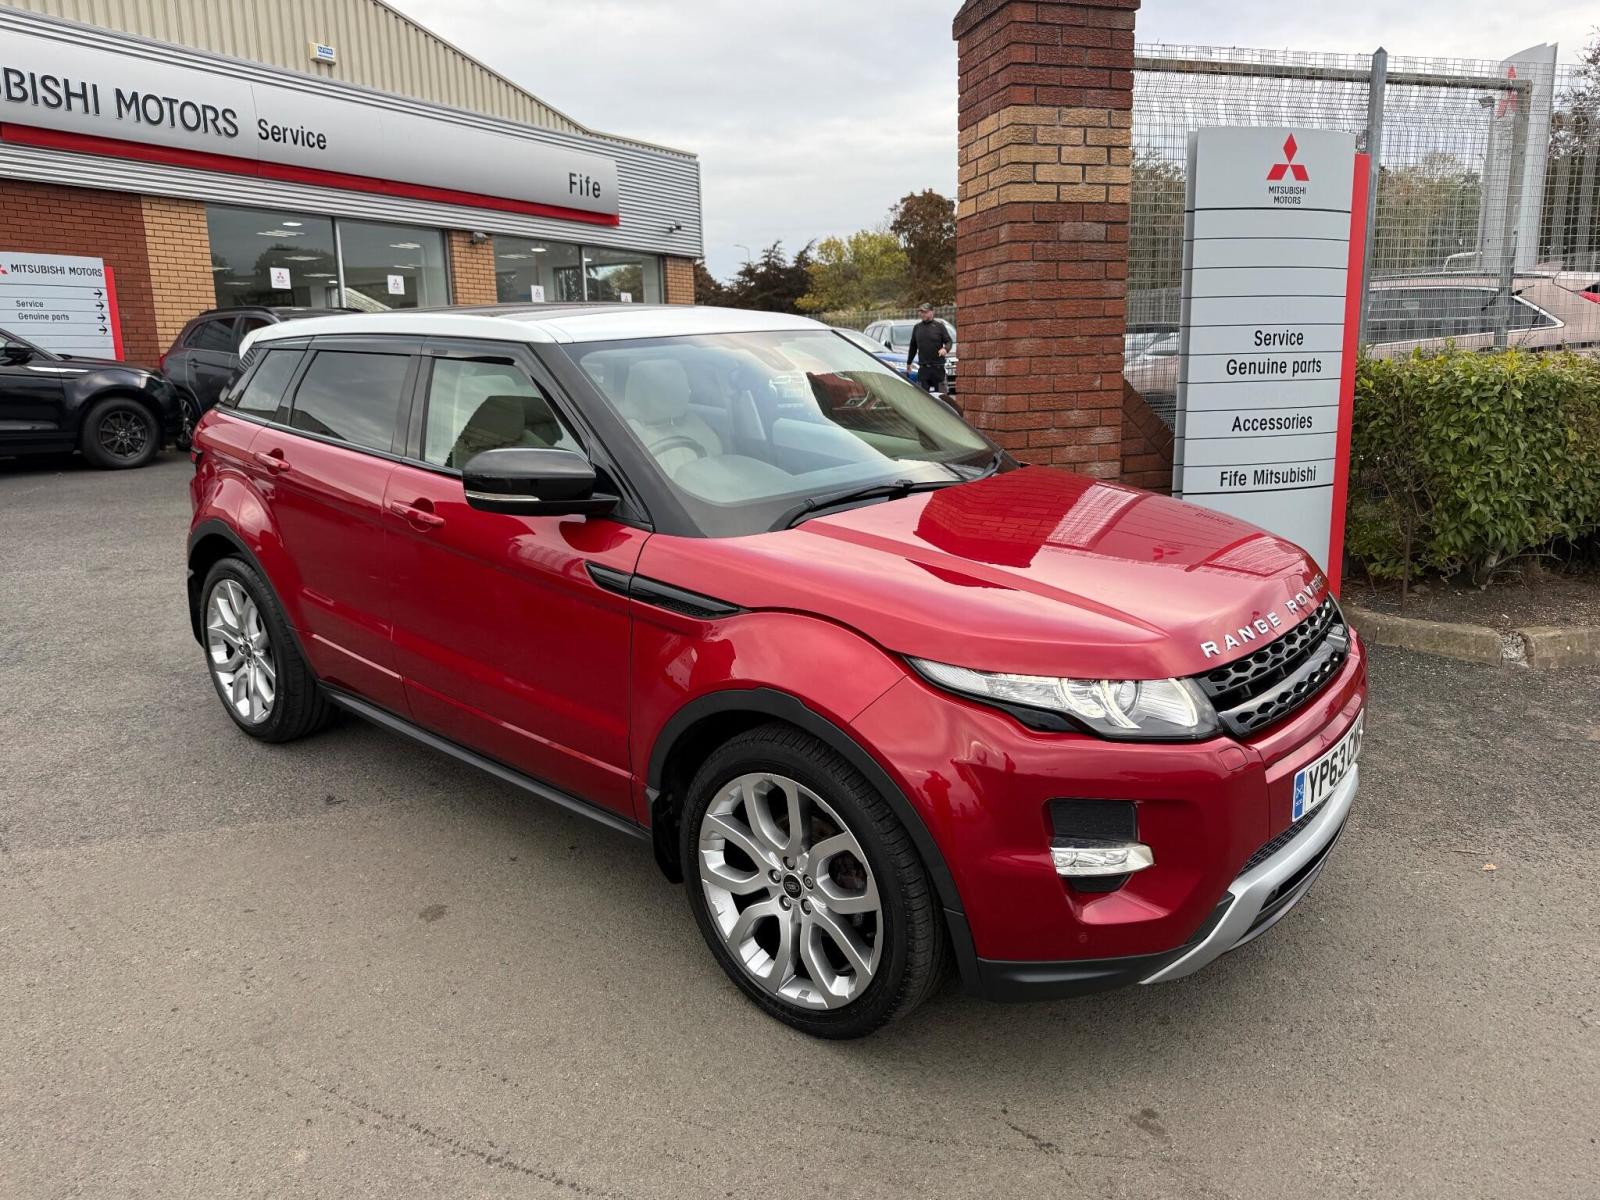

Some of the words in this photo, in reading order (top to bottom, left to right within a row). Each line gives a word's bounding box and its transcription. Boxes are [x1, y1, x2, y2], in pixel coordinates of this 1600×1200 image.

[0, 67, 100, 115] BISHI
[115, 87, 239, 137] MOTORS
[257, 118, 327, 150] Service
[569, 172, 601, 198] Fife
[1268, 185, 1307, 195] MITSUBISHI
[1273, 196, 1302, 204] MOTORS
[10, 264, 65, 275] MITSUBISHI
[68, 267, 103, 277] MOTORS
[16, 300, 44, 308] Service
[18, 312, 50, 321] Genuine
[52, 313, 70, 324] parts
[1254, 329, 1304, 347] Service
[1226, 357, 1287, 375] Genuine
[1292, 357, 1322, 377] parts
[1231, 413, 1313, 432] Accessories
[1220, 470, 1247, 487] Fife
[1253, 465, 1317, 486] Mitsubishi
[1200, 611, 1282, 659] RANGE
[1308, 742, 1346, 804] YP63
